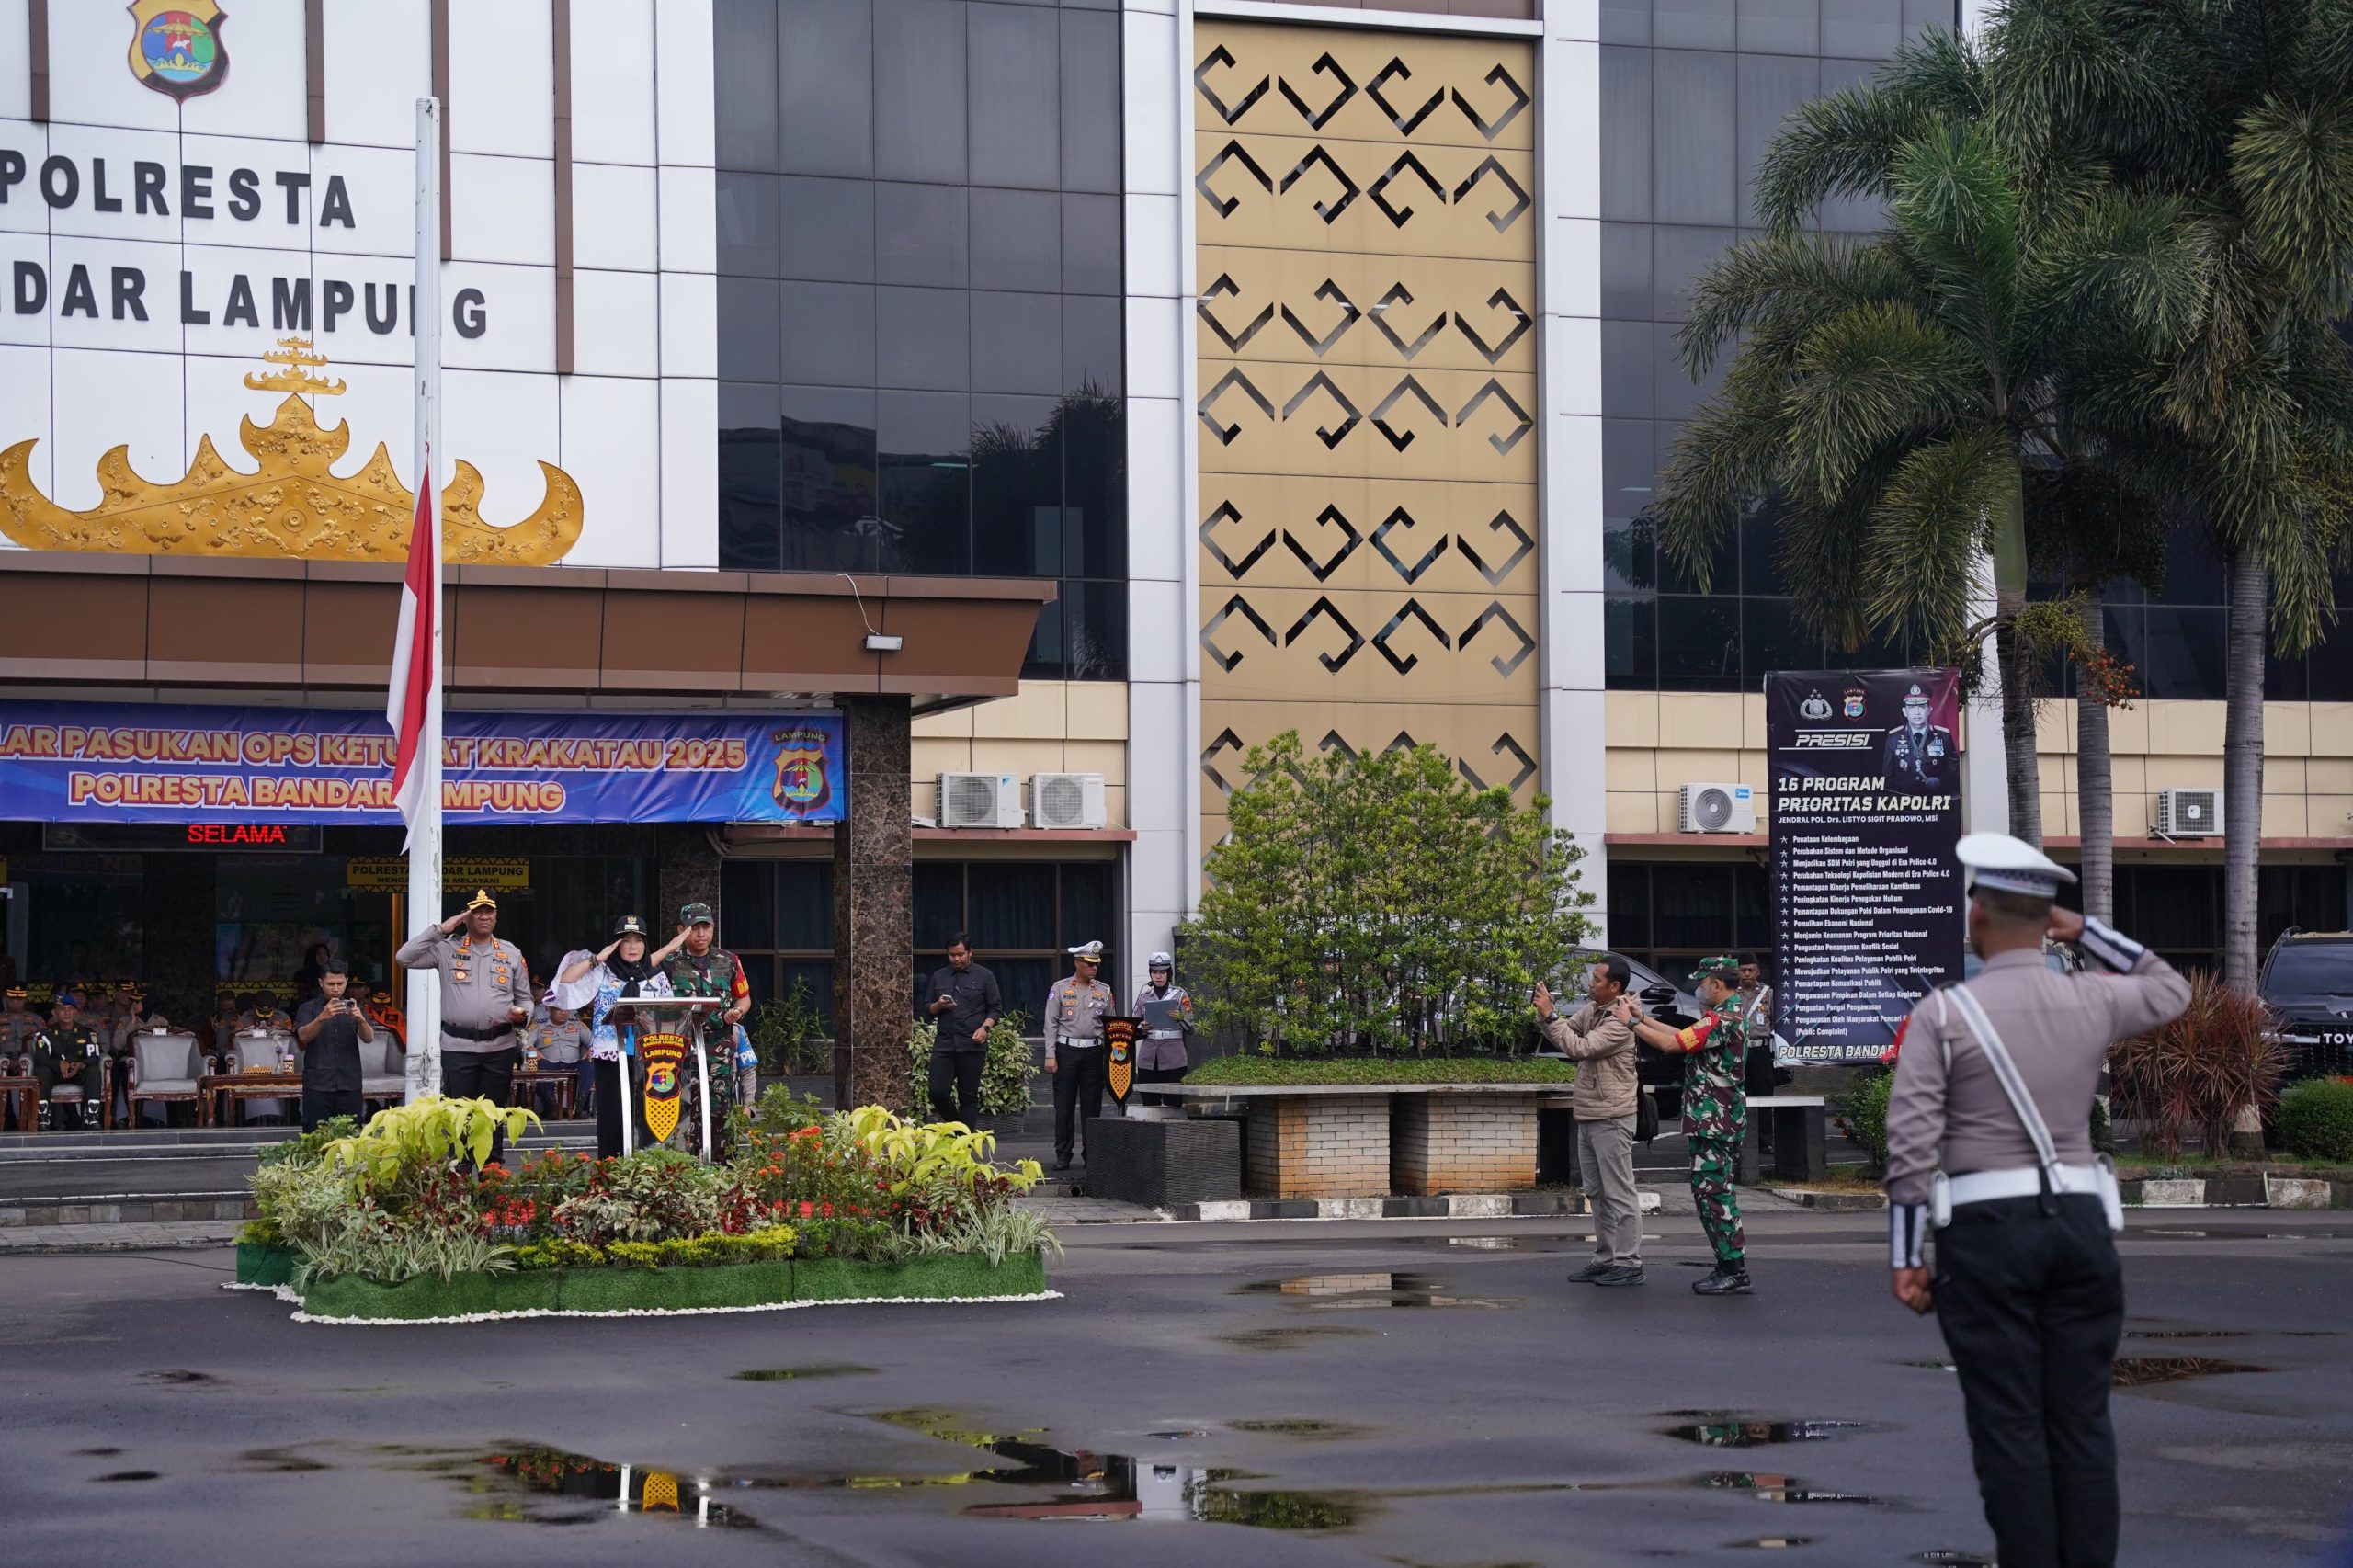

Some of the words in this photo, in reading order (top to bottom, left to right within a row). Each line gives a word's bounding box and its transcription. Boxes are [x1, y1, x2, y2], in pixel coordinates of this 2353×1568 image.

[0, 149, 356, 229] POLRESTA
[0, 260, 149, 321] DAR
[181, 269, 487, 339] LAMPUG
[775, 731, 826, 742] LAMPUNG
[1796, 734, 1870, 746] PRESISI
[62, 727, 239, 762] PASUKAN
[244, 733, 314, 765] OPS
[478, 738, 663, 769] KRAKATAU
[665, 738, 747, 769] 2025
[1779, 778, 1798, 791] 16
[1803, 777, 1885, 790] PROGRAM
[72, 773, 249, 807] POLRESTA
[1779, 797, 1872, 811] PRIORITAS
[1877, 796, 1951, 810] KAPOLRI
[188, 824, 288, 843] SELAMA
[1879, 846, 1908, 855] Organisasi
[467, 866, 523, 876] LAMPUNG
[1794, 896, 1828, 904] Peningkatan
[1851, 895, 1881, 903] Penegakan
[1794, 908, 1828, 916] Pemantapan
[1794, 932, 1822, 940] Menjamin
[1794, 944, 1824, 952] Penguatan
[1794, 956, 1829, 964] Peningkatan
[1832, 992, 1858, 1000] Pimpinan
[1878, 991, 1895, 999] Setiap
[1897, 991, 1922, 999] Kegiatan
[1827, 1004, 1845, 1012] Fungsi
[1846, 1016, 1879, 1024] Masyarakat
[1817, 1028, 1847, 1036] Complaint)
[643, 1034, 684, 1043] POLRESTA
[644, 1049, 683, 1059] LAMPUNG
[1779, 1046, 1843, 1059] POLRESTA
